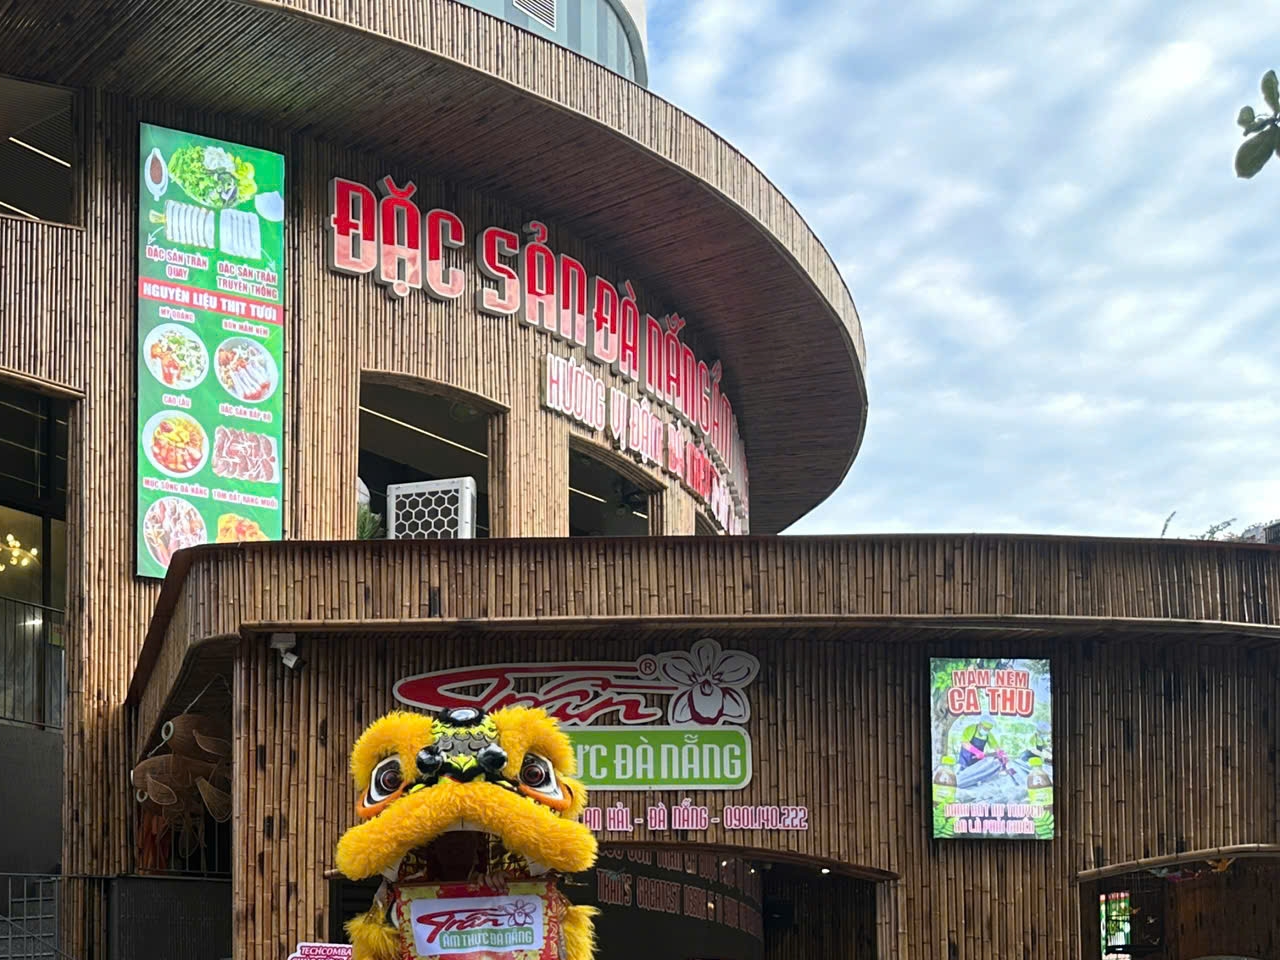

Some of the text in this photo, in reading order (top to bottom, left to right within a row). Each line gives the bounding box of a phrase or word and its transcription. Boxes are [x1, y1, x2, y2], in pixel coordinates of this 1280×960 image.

[146, 246, 165, 262] ĐẶC
[218, 261, 234, 276] ĐẶC
[167, 264, 188, 279] QUAY
[329, 175, 465, 299] ĐẶC
[480, 221, 588, 347] SẢN
[590, 276, 640, 383] ĐÀ
[143, 282, 277, 320] NGUYÊN LIỆU THỊT TƯƠI
[546, 352, 606, 431] HƯƠNG
[609, 386, 628, 451] VỊ
[948, 685, 1035, 717] CÁ THU
[613, 737, 654, 780] ĐÀ
[661, 734, 742, 780] NẴNG
[648, 802, 667, 830] ĐÀ
[671, 800, 709, 830] NẴNG
[723, 806, 808, 830] 0901.140.222
[443, 930, 531, 948] ẨM THỰC ĐÀ NẴNG
